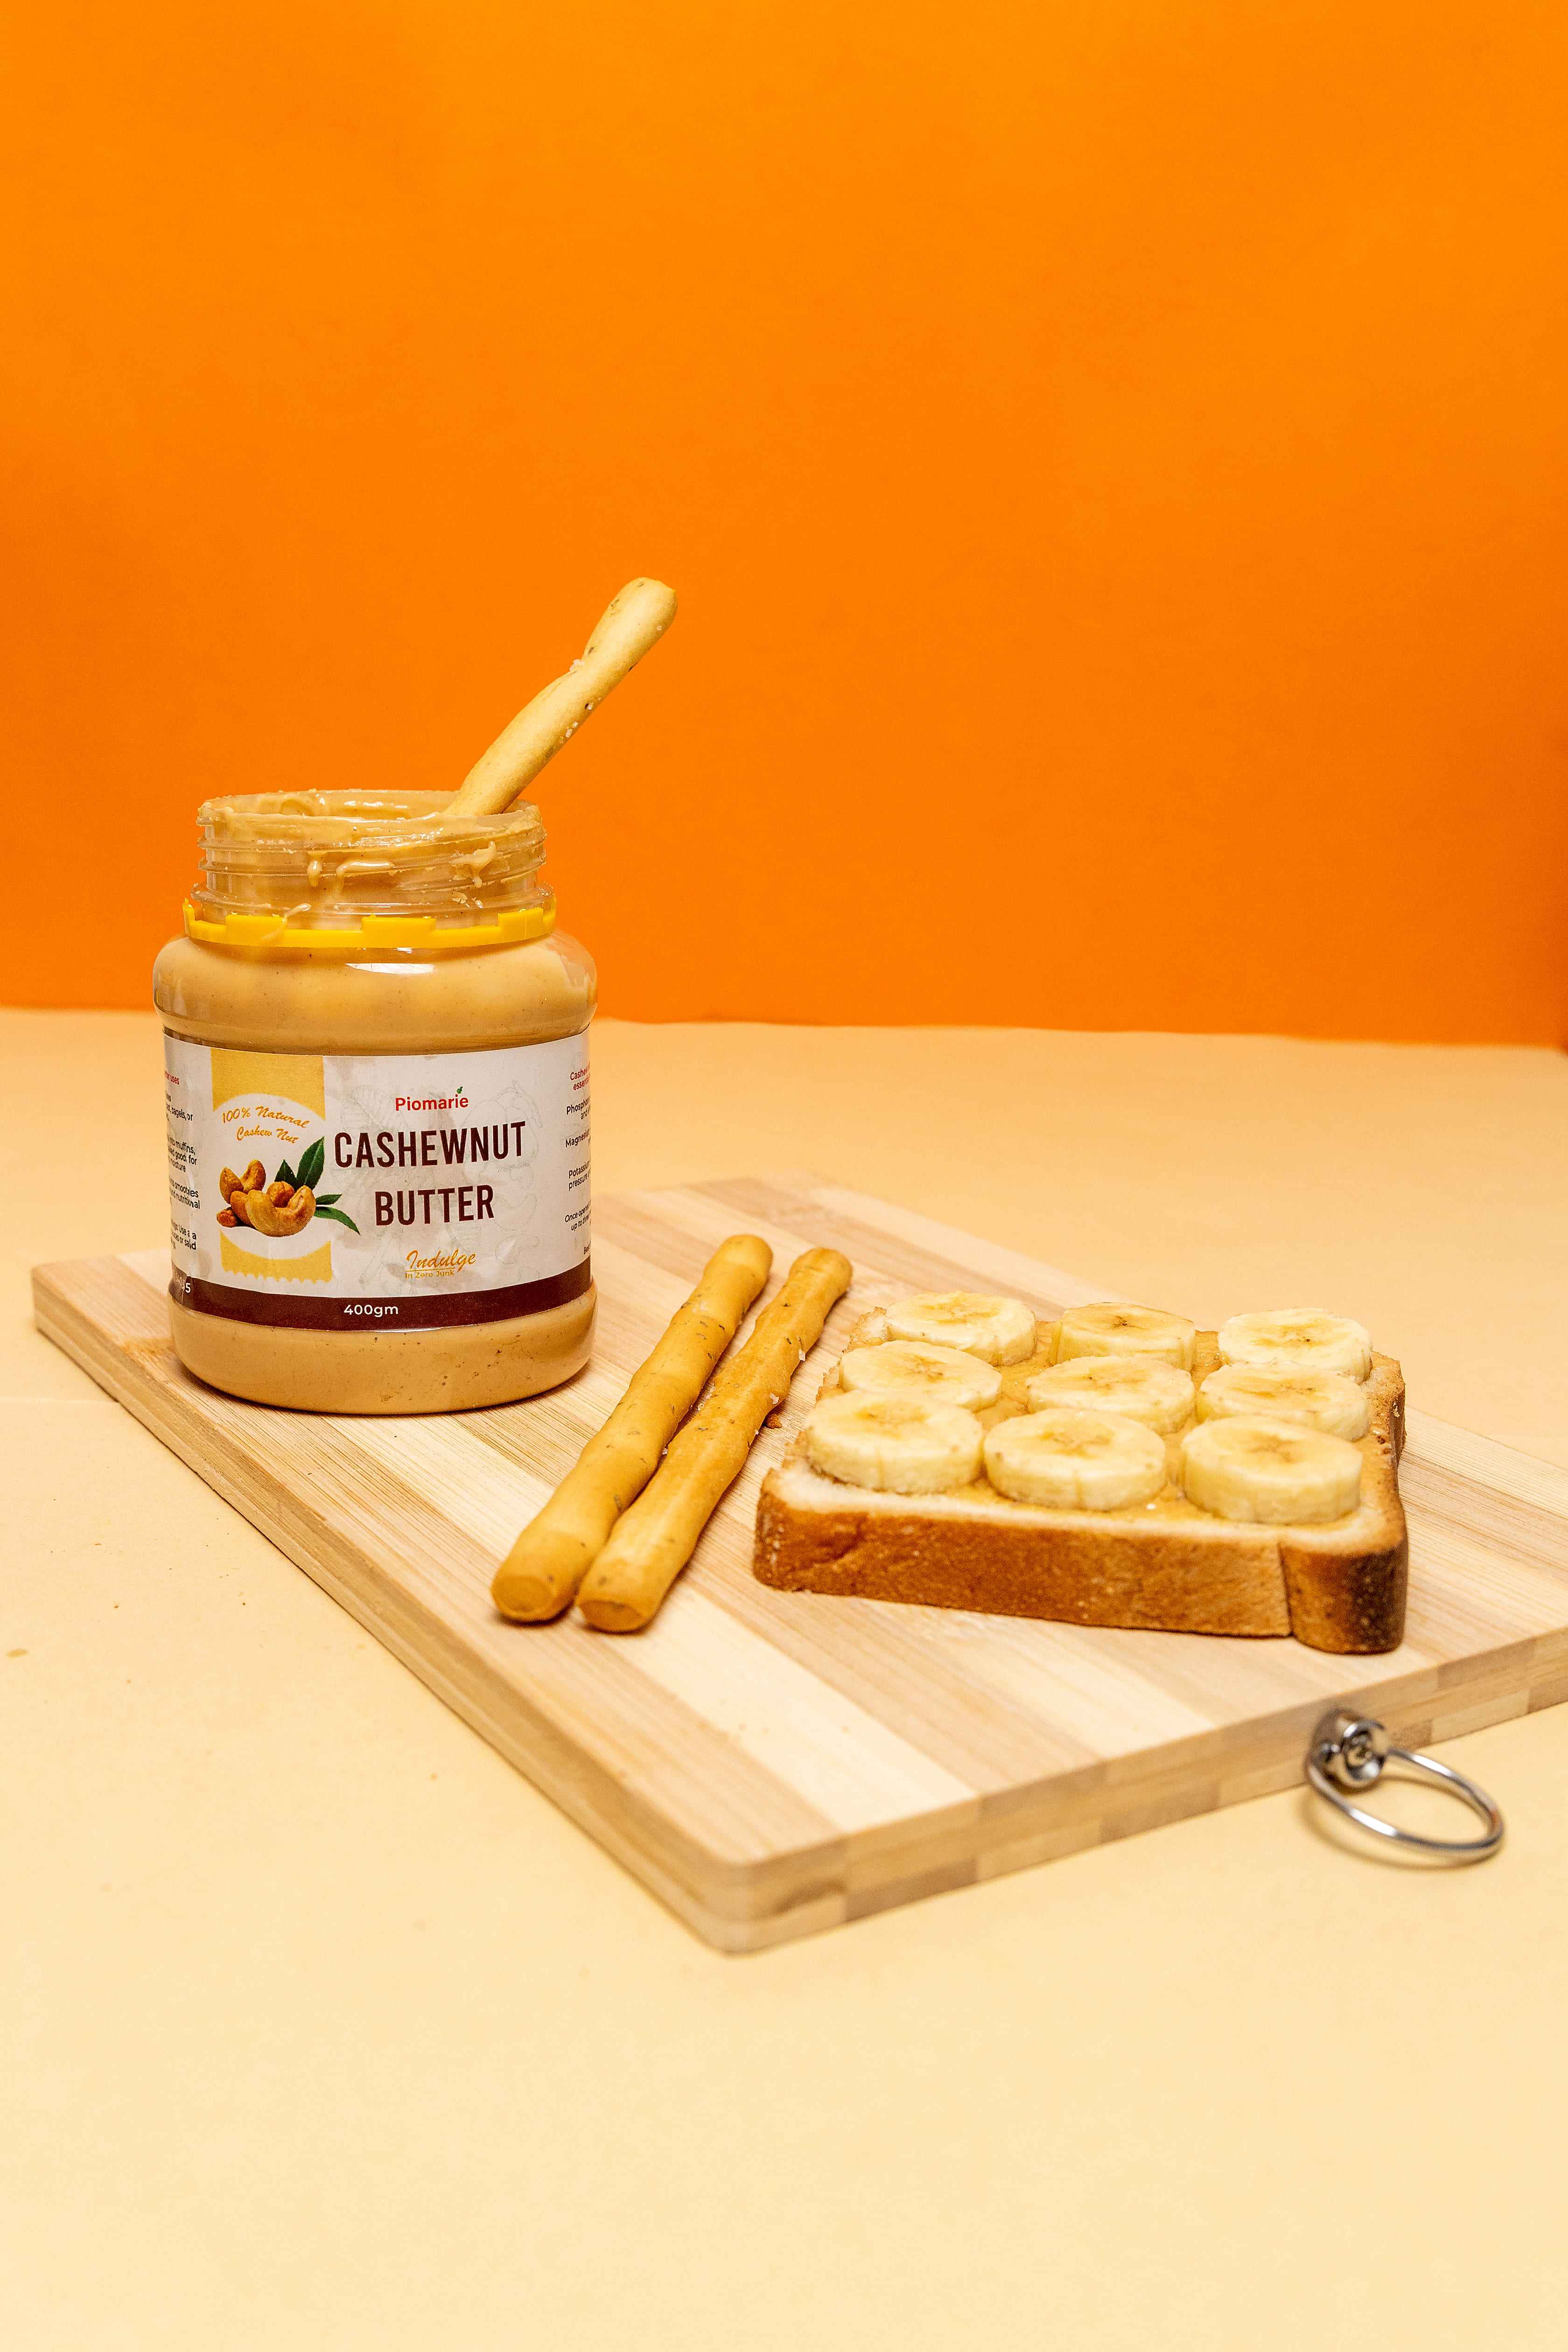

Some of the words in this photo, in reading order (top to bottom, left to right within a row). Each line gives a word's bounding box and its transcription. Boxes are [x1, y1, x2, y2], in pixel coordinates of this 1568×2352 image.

[395, 1094, 469, 1111] Piomarie
[222, 1107, 250, 1123] 100%
[255, 1106, 309, 1128] Natural
[236, 1124, 272, 1141] Cashew
[276, 1128, 299, 1144] Nut
[175, 1141, 196, 1155] muffns,
[334, 1121, 526, 1168] CASHEWNUT
[188, 1155, 197, 1165] for
[375, 1184, 495, 1226] BUTTER
[565, 1212, 578, 1223] Once
[178, 1224, 187, 1236] Use
[184, 1239, 196, 1250] sald
[406, 1248, 476, 1273] Indulge
[343, 1304, 399, 1318] 400gm
